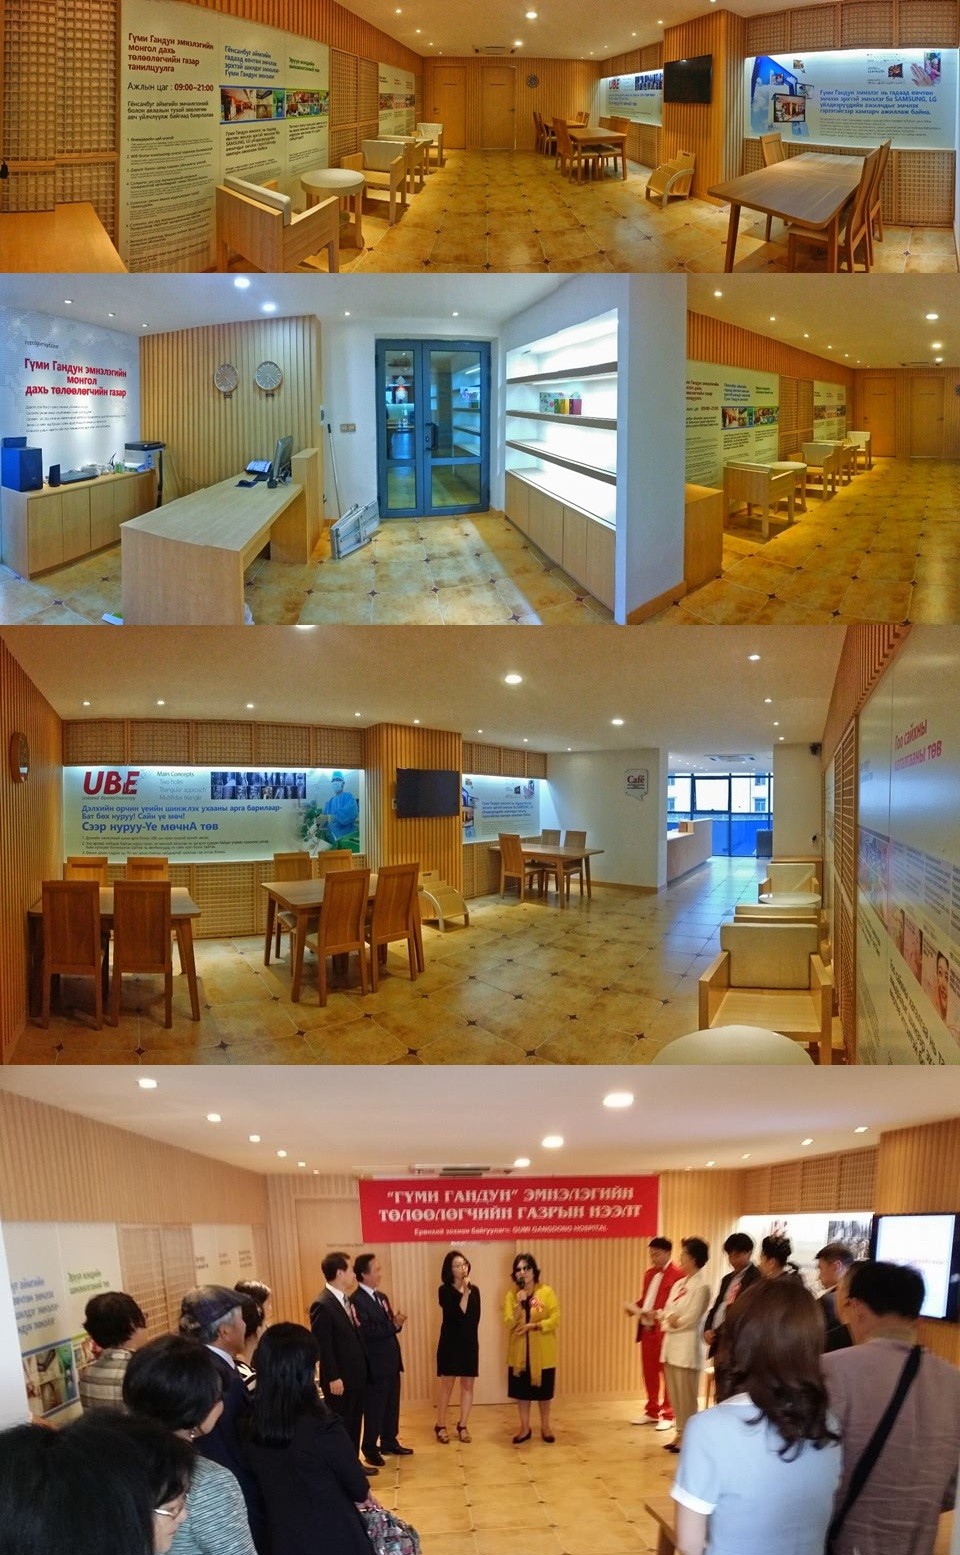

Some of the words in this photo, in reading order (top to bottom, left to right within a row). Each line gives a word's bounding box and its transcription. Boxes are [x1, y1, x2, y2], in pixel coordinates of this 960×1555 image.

[128, 33, 148, 43] Гүми
[150, 35, 175, 46] Гандун
[128, 45, 156, 53] монгол
[182, 58, 199, 66] газар
[128, 64, 175, 73] танилцуулга
[127, 82, 155, 91] Ажлын
[156, 84, 168, 92] цаг
[24, 358, 49, 372] Гүми
[52, 360, 83, 375] Гандун
[85, 366, 127, 378] эмнэлэгийн
[66, 376, 97, 385] монгол
[25, 385, 49, 396] дахь
[51, 386, 108, 396] төлөөлөгчийн
[83, 770, 141, 796] UBE
[229, 805, 245, 813] арга
[111, 813, 136, 821] нуруу!
[138, 812, 156, 820] Сайн
[82, 822, 106, 833] Сээр
[200, 823, 219, 831] төв
[523, 1185, 635, 1202] ЭМНЭЛЭГИЙН
[378, 1205, 513, 1222] ТӨЛӨӨЛӨГЧИЙН
[518, 1205, 585, 1220] ГАЗРЫН
[589, 1204, 643, 1219] НЭЭЛТ
